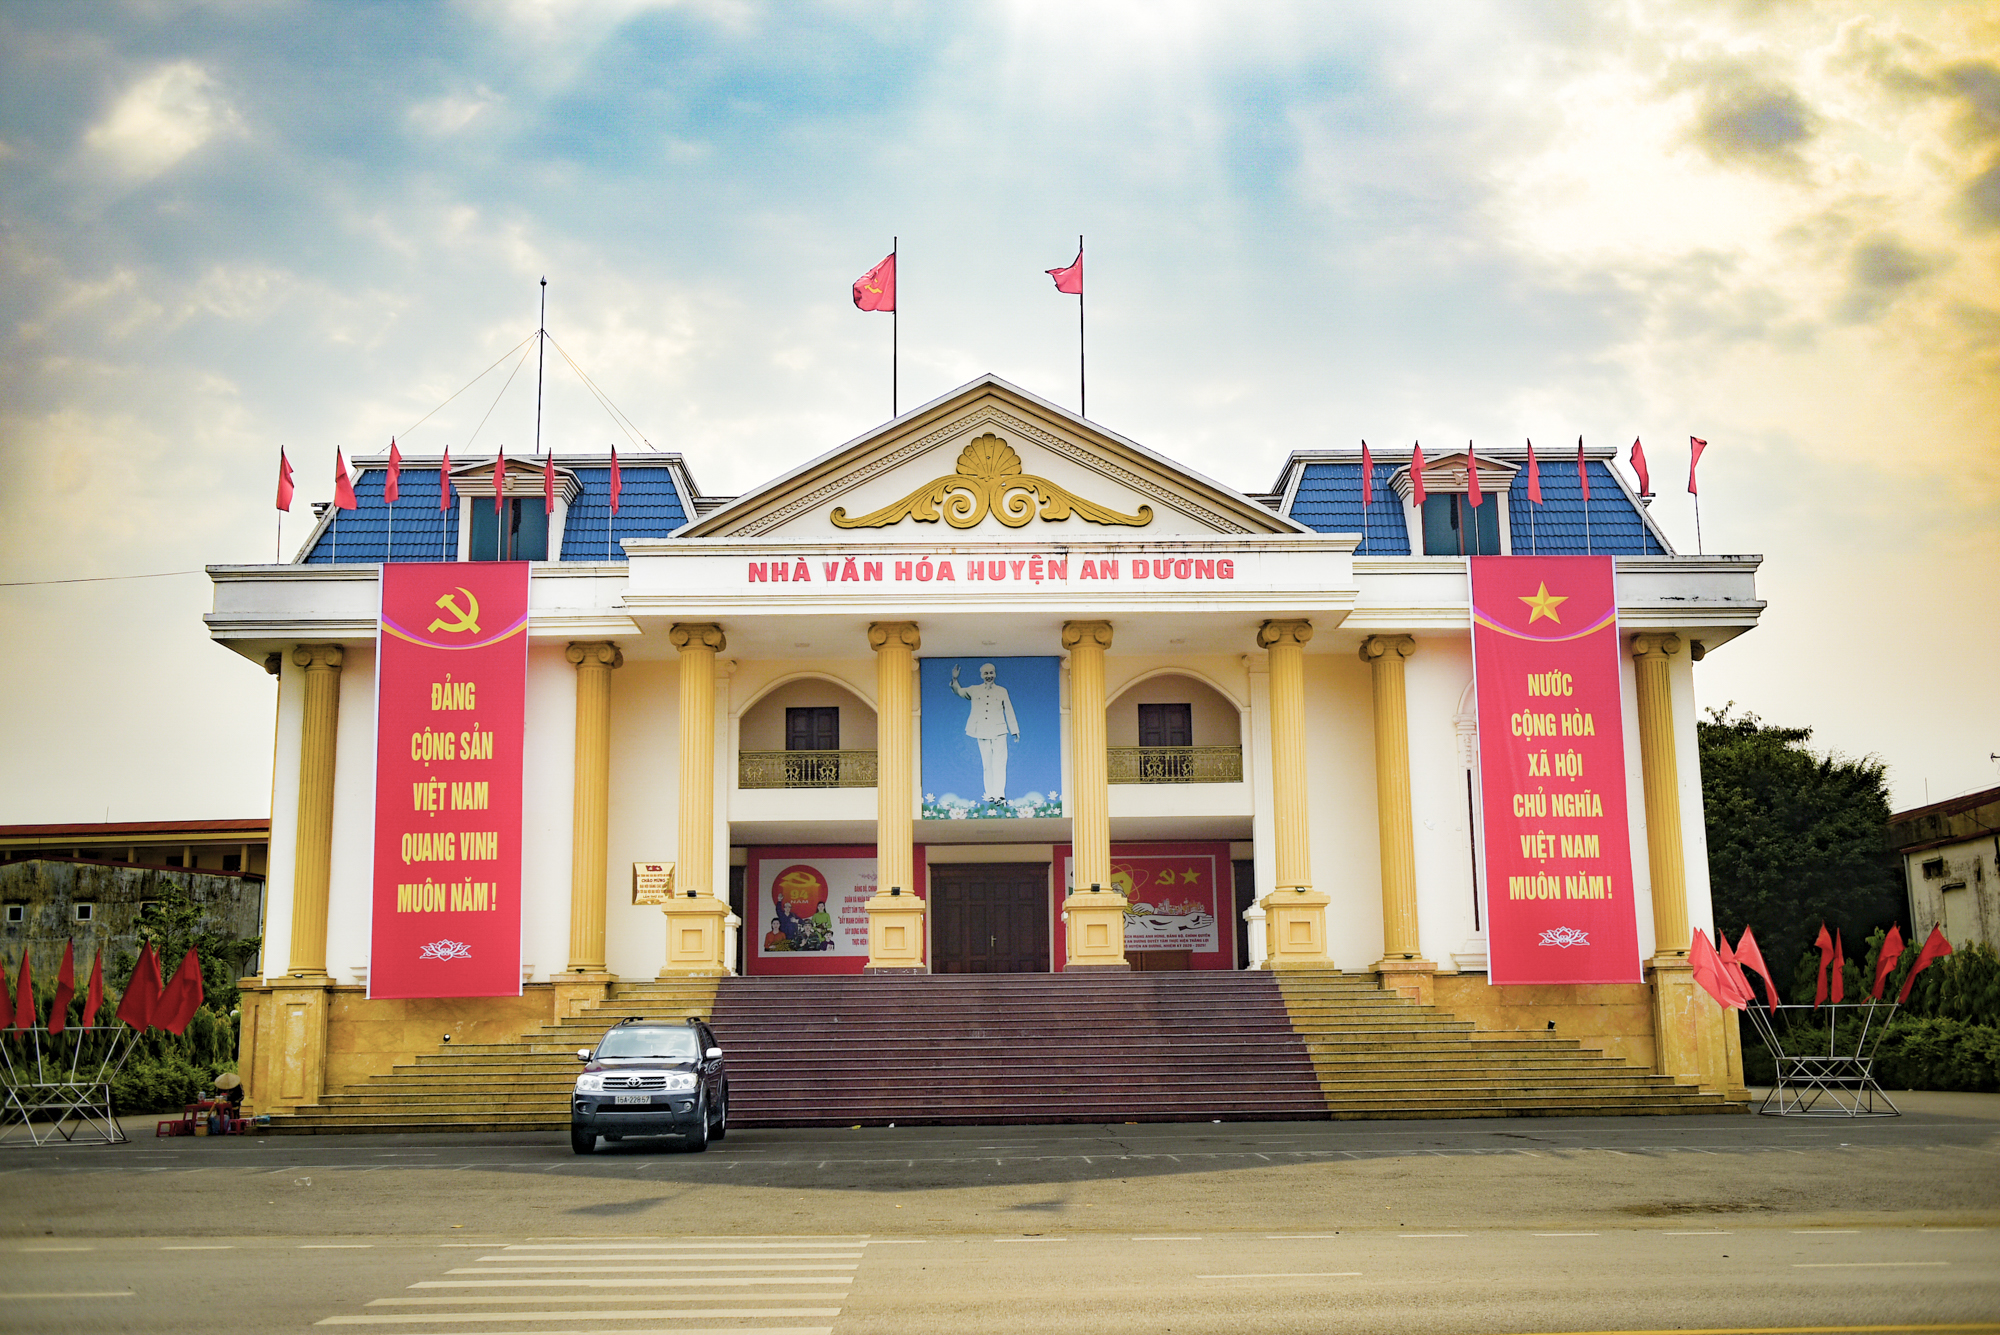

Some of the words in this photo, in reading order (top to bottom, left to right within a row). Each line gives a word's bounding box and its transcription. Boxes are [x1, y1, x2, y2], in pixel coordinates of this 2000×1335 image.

[748, 557, 811, 582] NHÀ
[822, 557, 883, 582] VĂN
[895, 556, 955, 582] HÓA
[967, 554, 1068, 585] HUYỆN
[1080, 559, 1119, 580] AN
[1132, 557, 1234, 580] DƯƠNG
[431, 673, 476, 711] ĐẢNG
[1527, 669, 1573, 697] NƯỚC
[1511, 708, 1557, 742] CỘNG
[1561, 708, 1595, 737] HÒA
[411, 726, 455, 767] CỘNG
[460, 722, 493, 760] SẢN
[1527, 749, 1551, 777] XÃ
[1555, 749, 1583, 782] HỘI
[413, 776, 447, 818] VIỆT
[451, 781, 489, 811] NAM
[1513, 786, 1547, 818] CHỦ
[1552, 789, 1603, 818] NGHĨA
[401, 832, 455, 865] QUANG
[460, 831, 498, 861] VINH
[1520, 830, 1556, 864] VIỆT
[1561, 834, 1600, 858] NAM
[397, 877, 446, 913] MUÔN
[790, 889, 808, 899] 94
[1509, 871, 1561, 900] MUÔN
